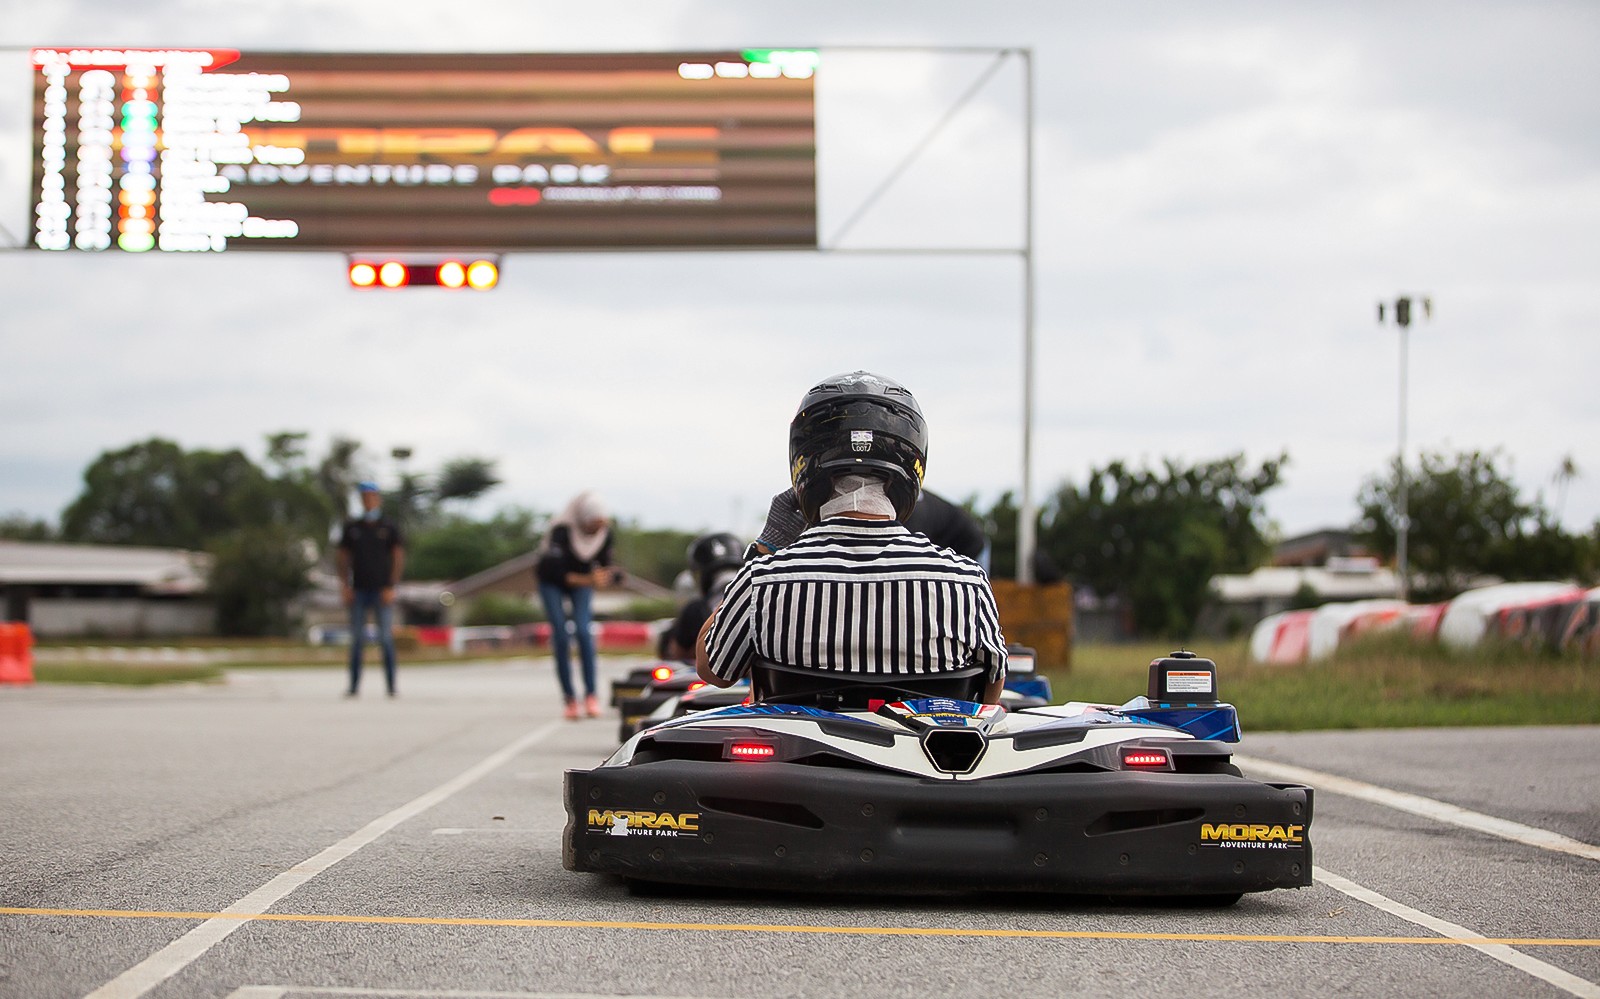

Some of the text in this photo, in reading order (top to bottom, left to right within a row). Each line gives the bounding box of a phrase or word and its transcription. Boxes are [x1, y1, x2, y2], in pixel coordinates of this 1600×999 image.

[605, 827, 653, 836] ANTURE
[1200, 823, 1303, 842] MORAC
[1220, 841, 1266, 849] ADVENTURE
